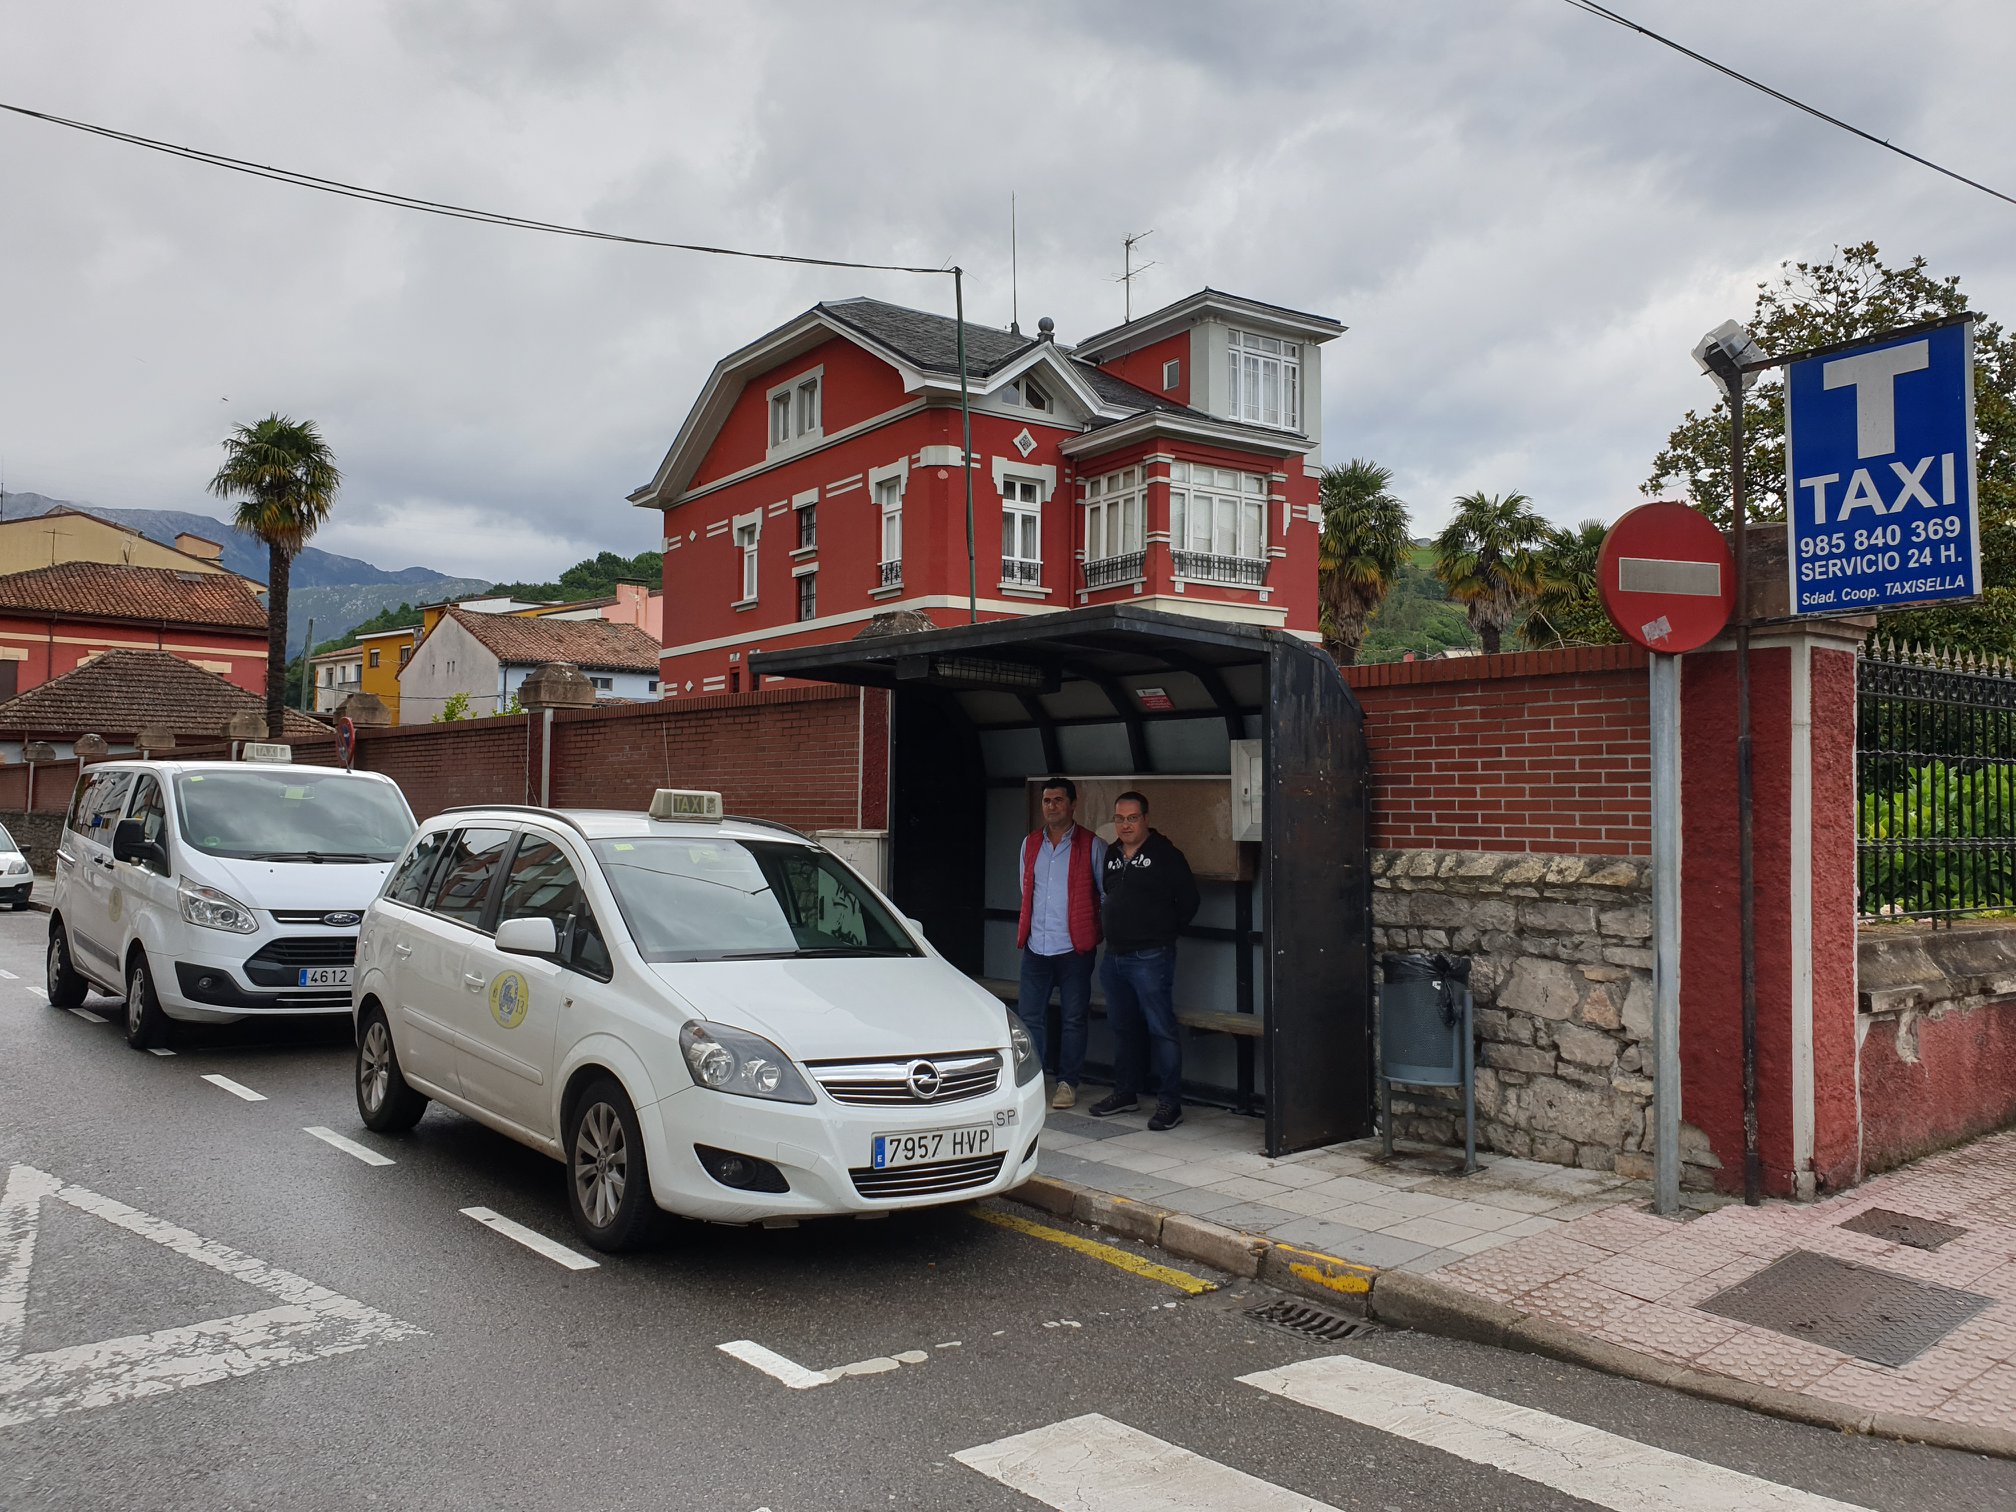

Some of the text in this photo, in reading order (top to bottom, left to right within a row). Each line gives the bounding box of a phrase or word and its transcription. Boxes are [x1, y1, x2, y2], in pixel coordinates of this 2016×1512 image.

[1823, 339, 1929, 459] T
[1800, 453, 1955, 525] TAXI
[1800, 515, 1961, 558] 985 840 369
[1801, 543, 1963, 582] SERVICIO 24 H.
[1801, 574, 1965, 606] Sdad. Coop. TAXISELLA
[674, 796, 704, 813] TAXI
[310, 969, 347, 984] 4612
[996, 1109, 1016, 1127] SP
[877, 1129, 990, 1163] E 7957 HVP
